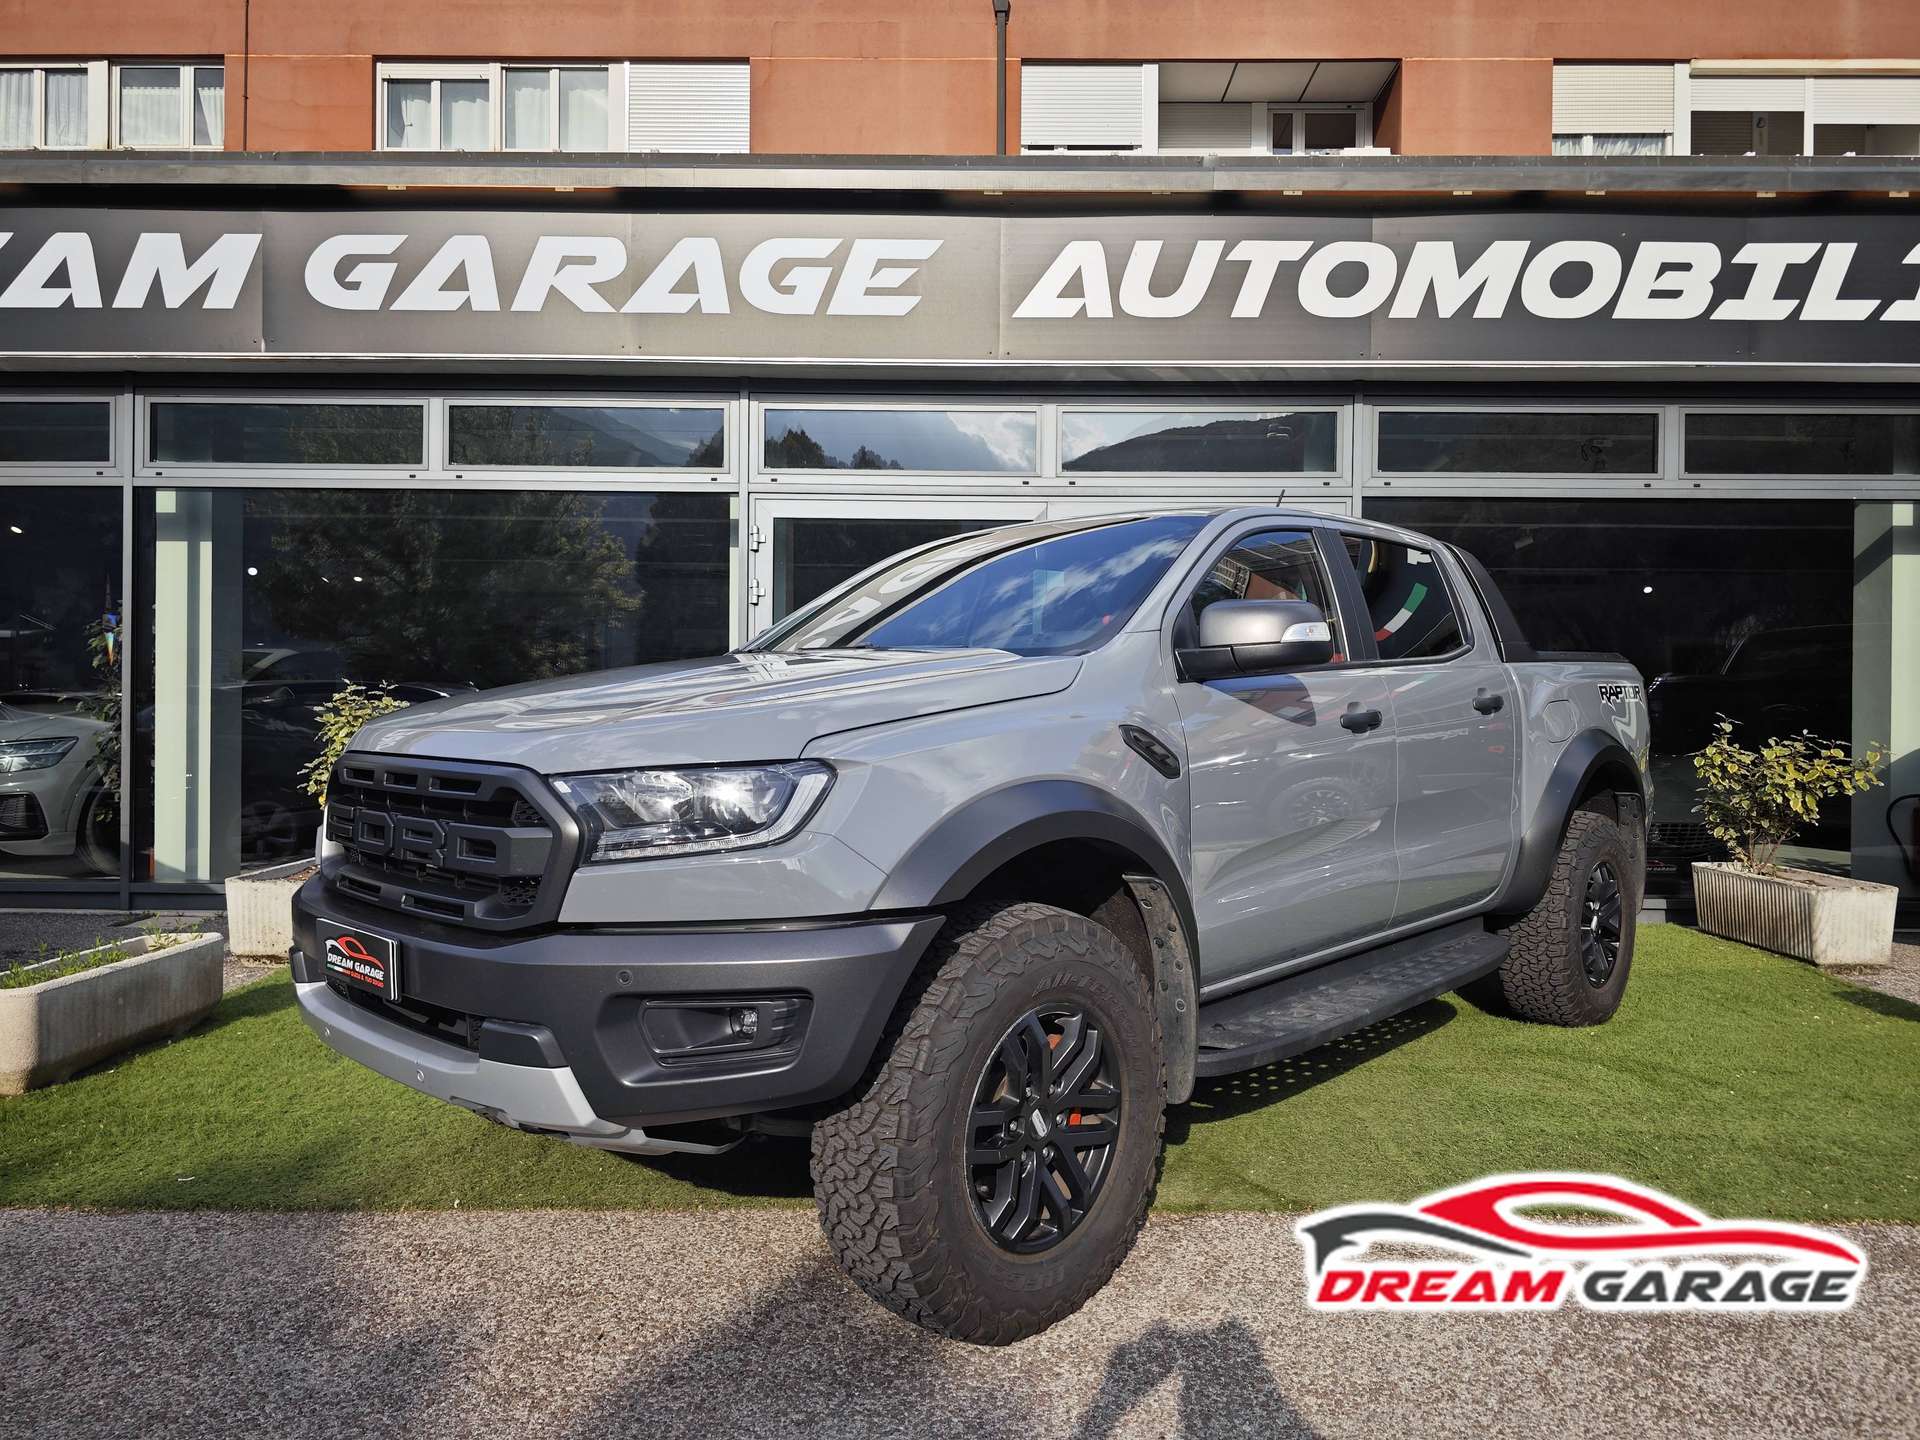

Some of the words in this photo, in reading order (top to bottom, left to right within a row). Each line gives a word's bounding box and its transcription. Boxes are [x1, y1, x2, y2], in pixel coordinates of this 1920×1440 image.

[0, 232, 262, 309] AM
[304, 234, 944, 316] GARAGE
[1598, 684, 1645, 710] RAPTOR
[326, 801, 520, 877] FORD
[327, 953, 354, 970] DREAM
[354, 962, 385, 981] GARAGE
